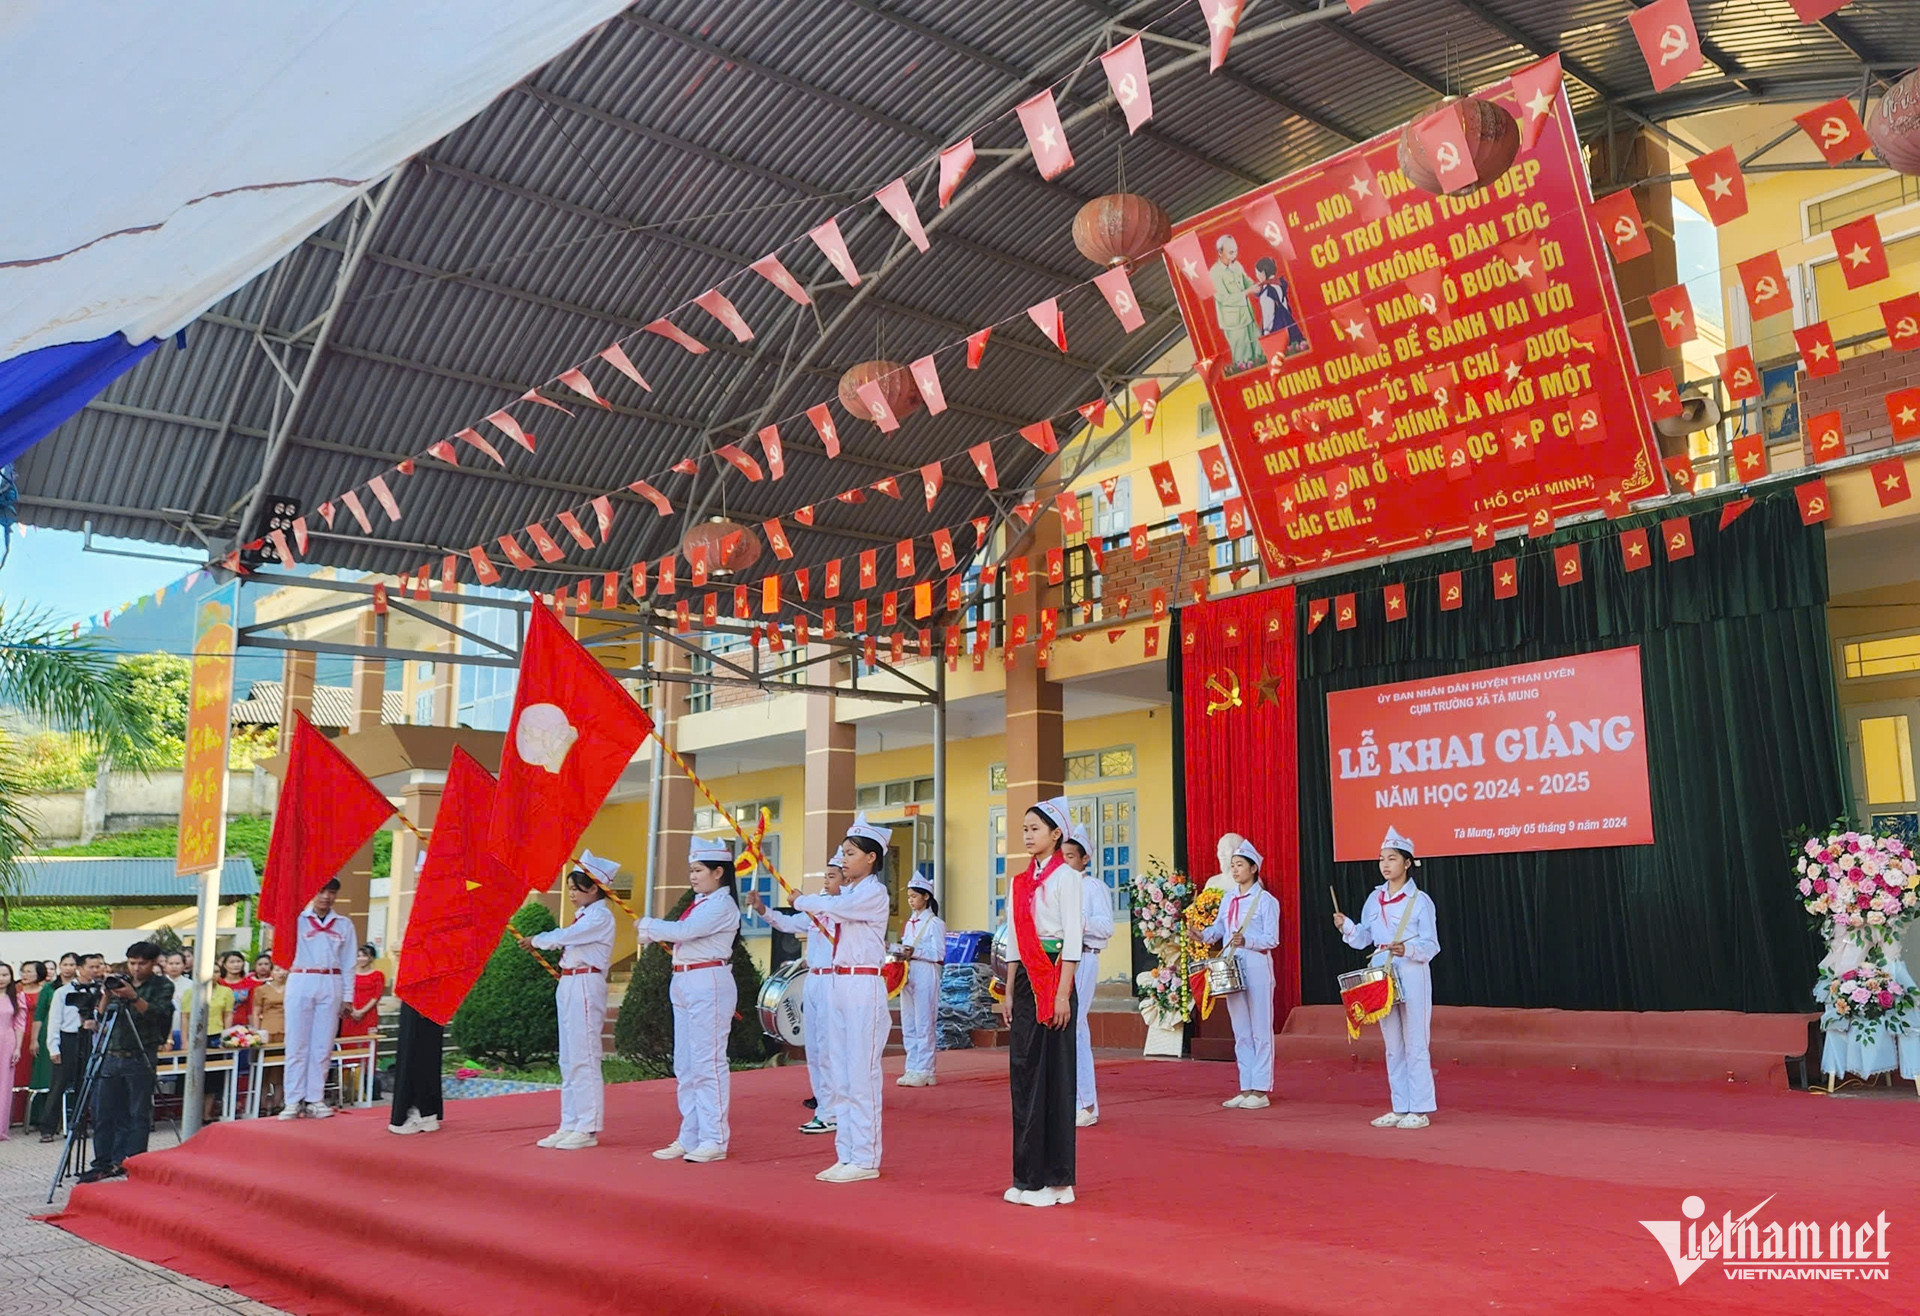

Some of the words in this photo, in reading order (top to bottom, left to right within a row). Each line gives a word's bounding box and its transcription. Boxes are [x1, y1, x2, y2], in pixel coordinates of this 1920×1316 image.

[1310, 231, 1340, 269] CÓ
[1386, 200, 1434, 240] NÊN
[1494, 158, 1541, 198] ĐẸP
[1320, 271, 1360, 306] HAY
[1365, 243, 1447, 290] KHÔNG,
[1448, 220, 1500, 261] DÂN
[1442, 274, 1459, 304] Ó
[1539, 237, 1565, 271] ỚI
[1241, 379, 1276, 410] ĐÀI
[1277, 365, 1323, 399] VINH
[1393, 322, 1424, 362] ĐỂ
[1489, 297, 1530, 331] VAI
[1532, 279, 1574, 317] VỚI
[1263, 446, 1300, 476] HAY
[1539, 362, 1592, 400] MỘT
[1466, 431, 1499, 464] ỌC
[1512, 483, 1541, 503] CHÍ
[1286, 512, 1323, 541] CÁC
[1393, 690, 1415, 702] BAN
[1416, 684, 1446, 699] NHÂN
[1447, 680, 1470, 695] DÂN
[1471, 675, 1509, 693] HUYỆN
[1510, 674, 1542, 686] THAN
[1543, 665, 1576, 681] UYÊN
[1409, 703, 1432, 716] CỤM
[1432, 693, 1475, 712] TRƯỜNG
[1507, 687, 1540, 701] MUNG
[1338, 728, 1381, 780] LỄ
[1387, 731, 1486, 775] KHAI
[1494, 710, 1636, 764] GIẢNG
[1374, 784, 1419, 809] NĂM
[1422, 782, 1468, 808] HỌC
[1473, 777, 1522, 802] 2024
[1539, 770, 1590, 796] 2025
[1467, 826, 1496, 840] Mung,
[1497, 824, 1522, 838] ngày
[1523, 823, 1536, 835] 05
[1537, 820, 1566, 836] tháng
[1568, 820, 1575, 831] 9
[1576, 817, 1600, 830] năm
[1602, 816, 1628, 829] 2024
